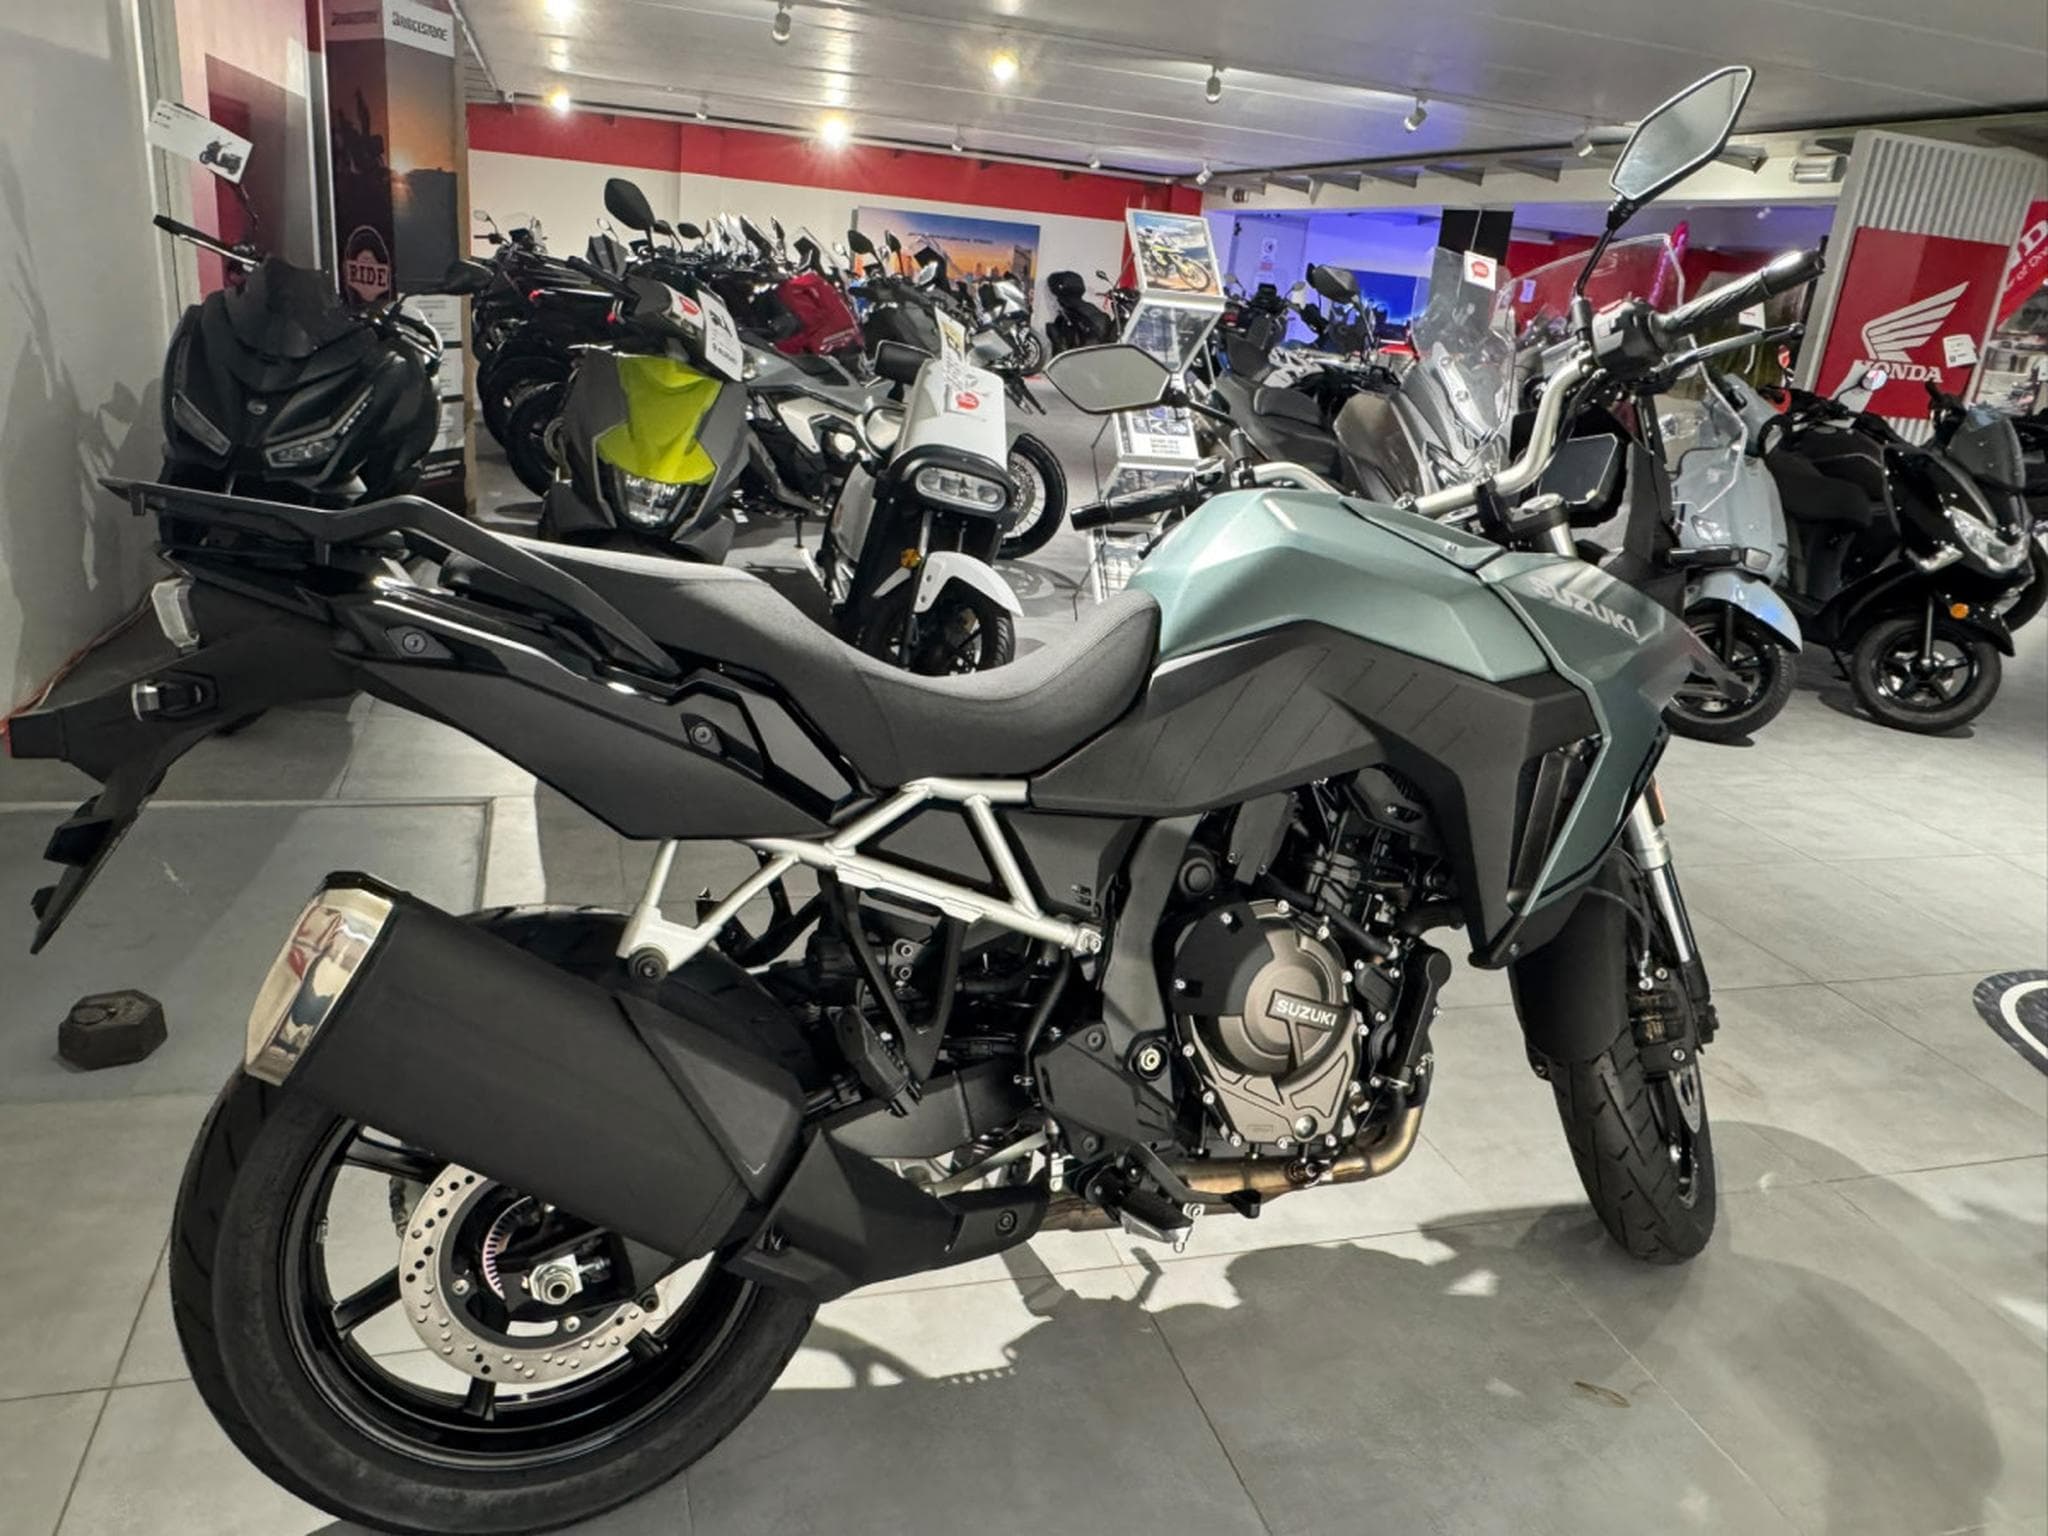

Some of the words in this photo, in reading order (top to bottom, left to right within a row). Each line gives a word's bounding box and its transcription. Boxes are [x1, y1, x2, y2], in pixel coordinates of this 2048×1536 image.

[349, 264, 386, 287] RIDE
[1528, 576, 1640, 641] SUZUKI
[1276, 999, 1338, 1027] SUZUKI
